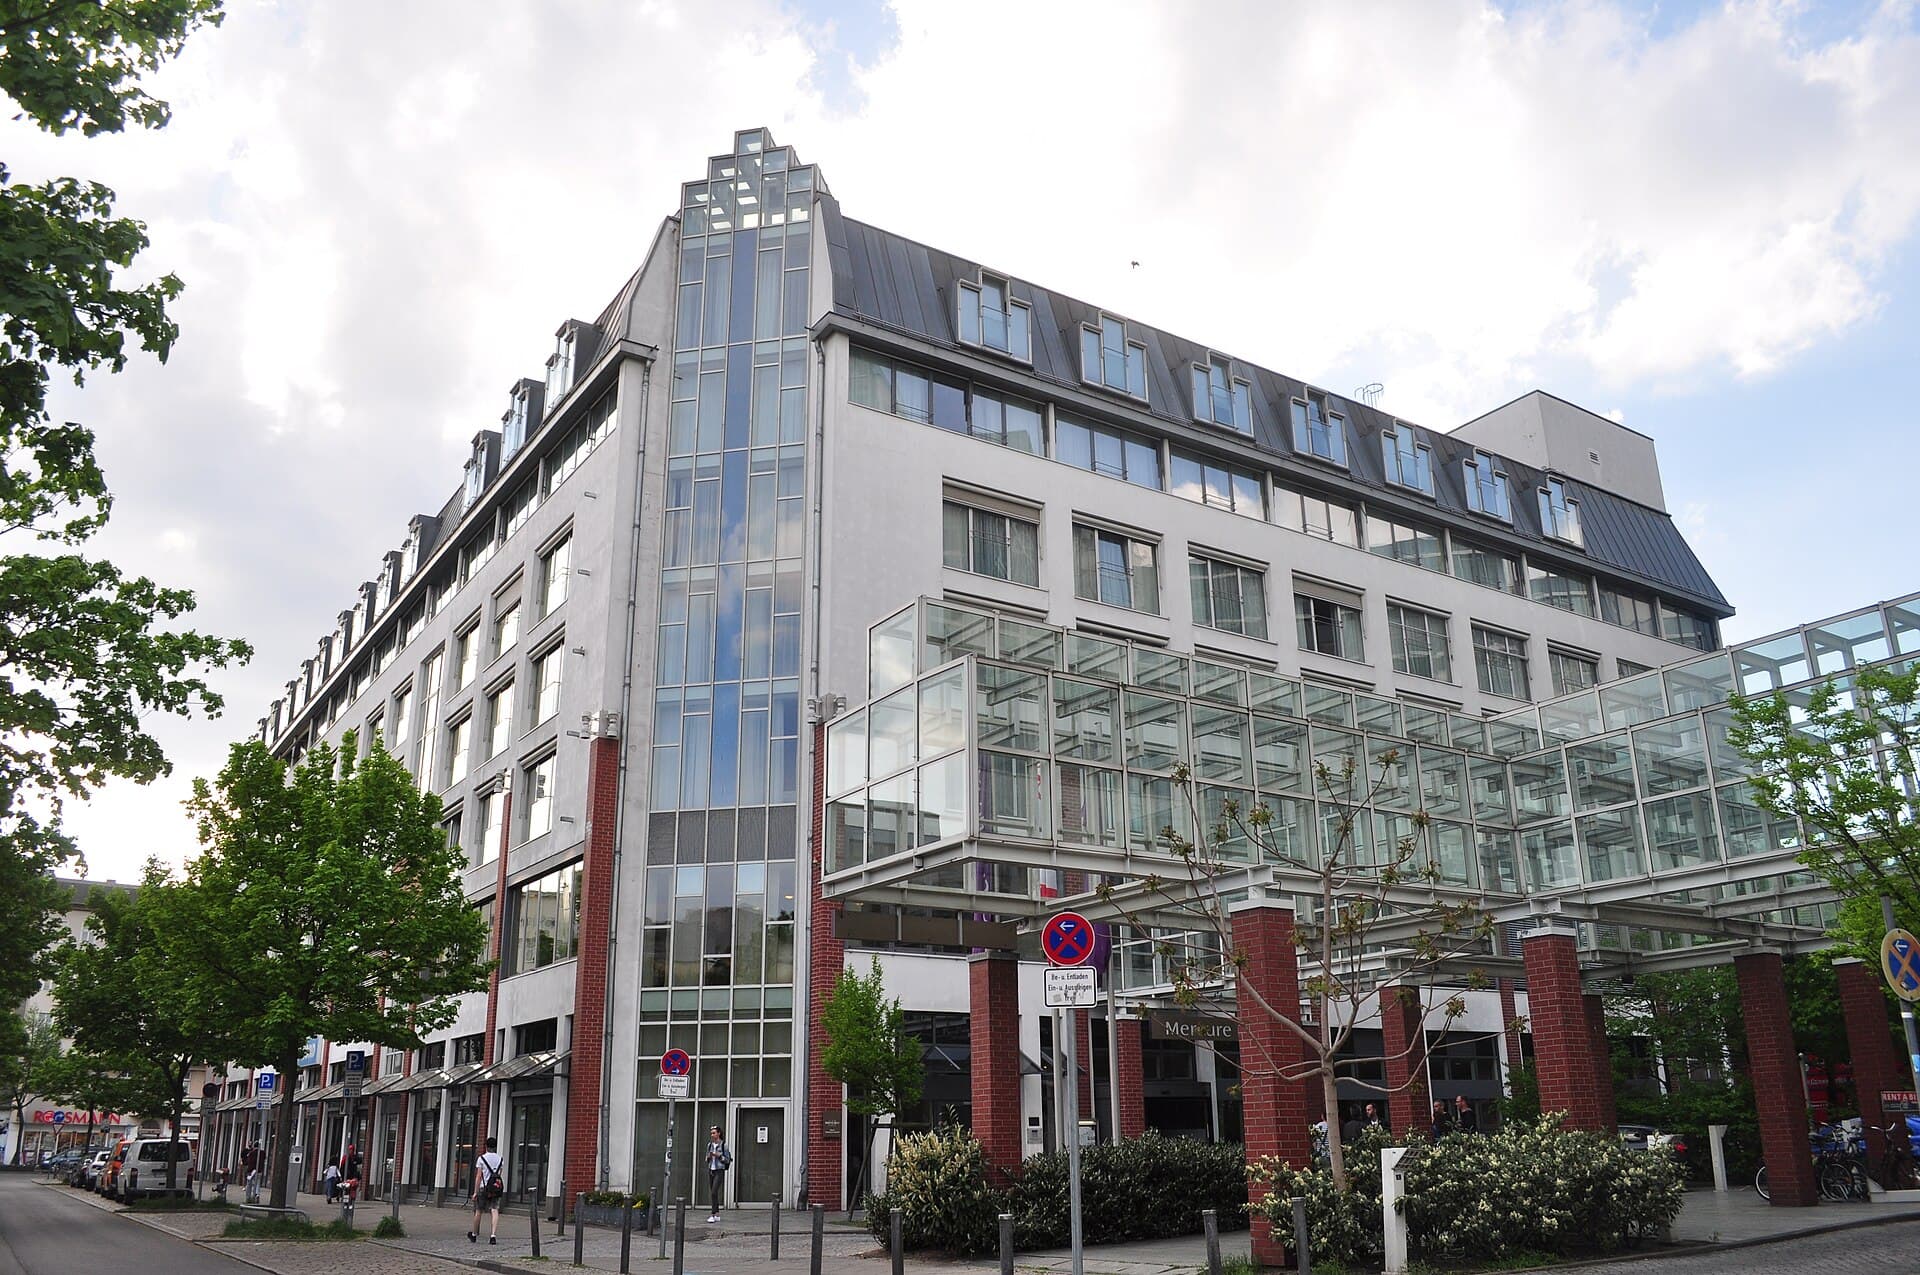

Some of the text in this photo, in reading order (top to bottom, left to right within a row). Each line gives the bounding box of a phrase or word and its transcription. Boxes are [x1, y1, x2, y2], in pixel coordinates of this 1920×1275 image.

[1165, 1021, 1232, 1037] Merure
[349, 1053, 359, 1069] P
[261, 1075, 270, 1087] P
[33, 1110, 121, 1124] ROSMAN
